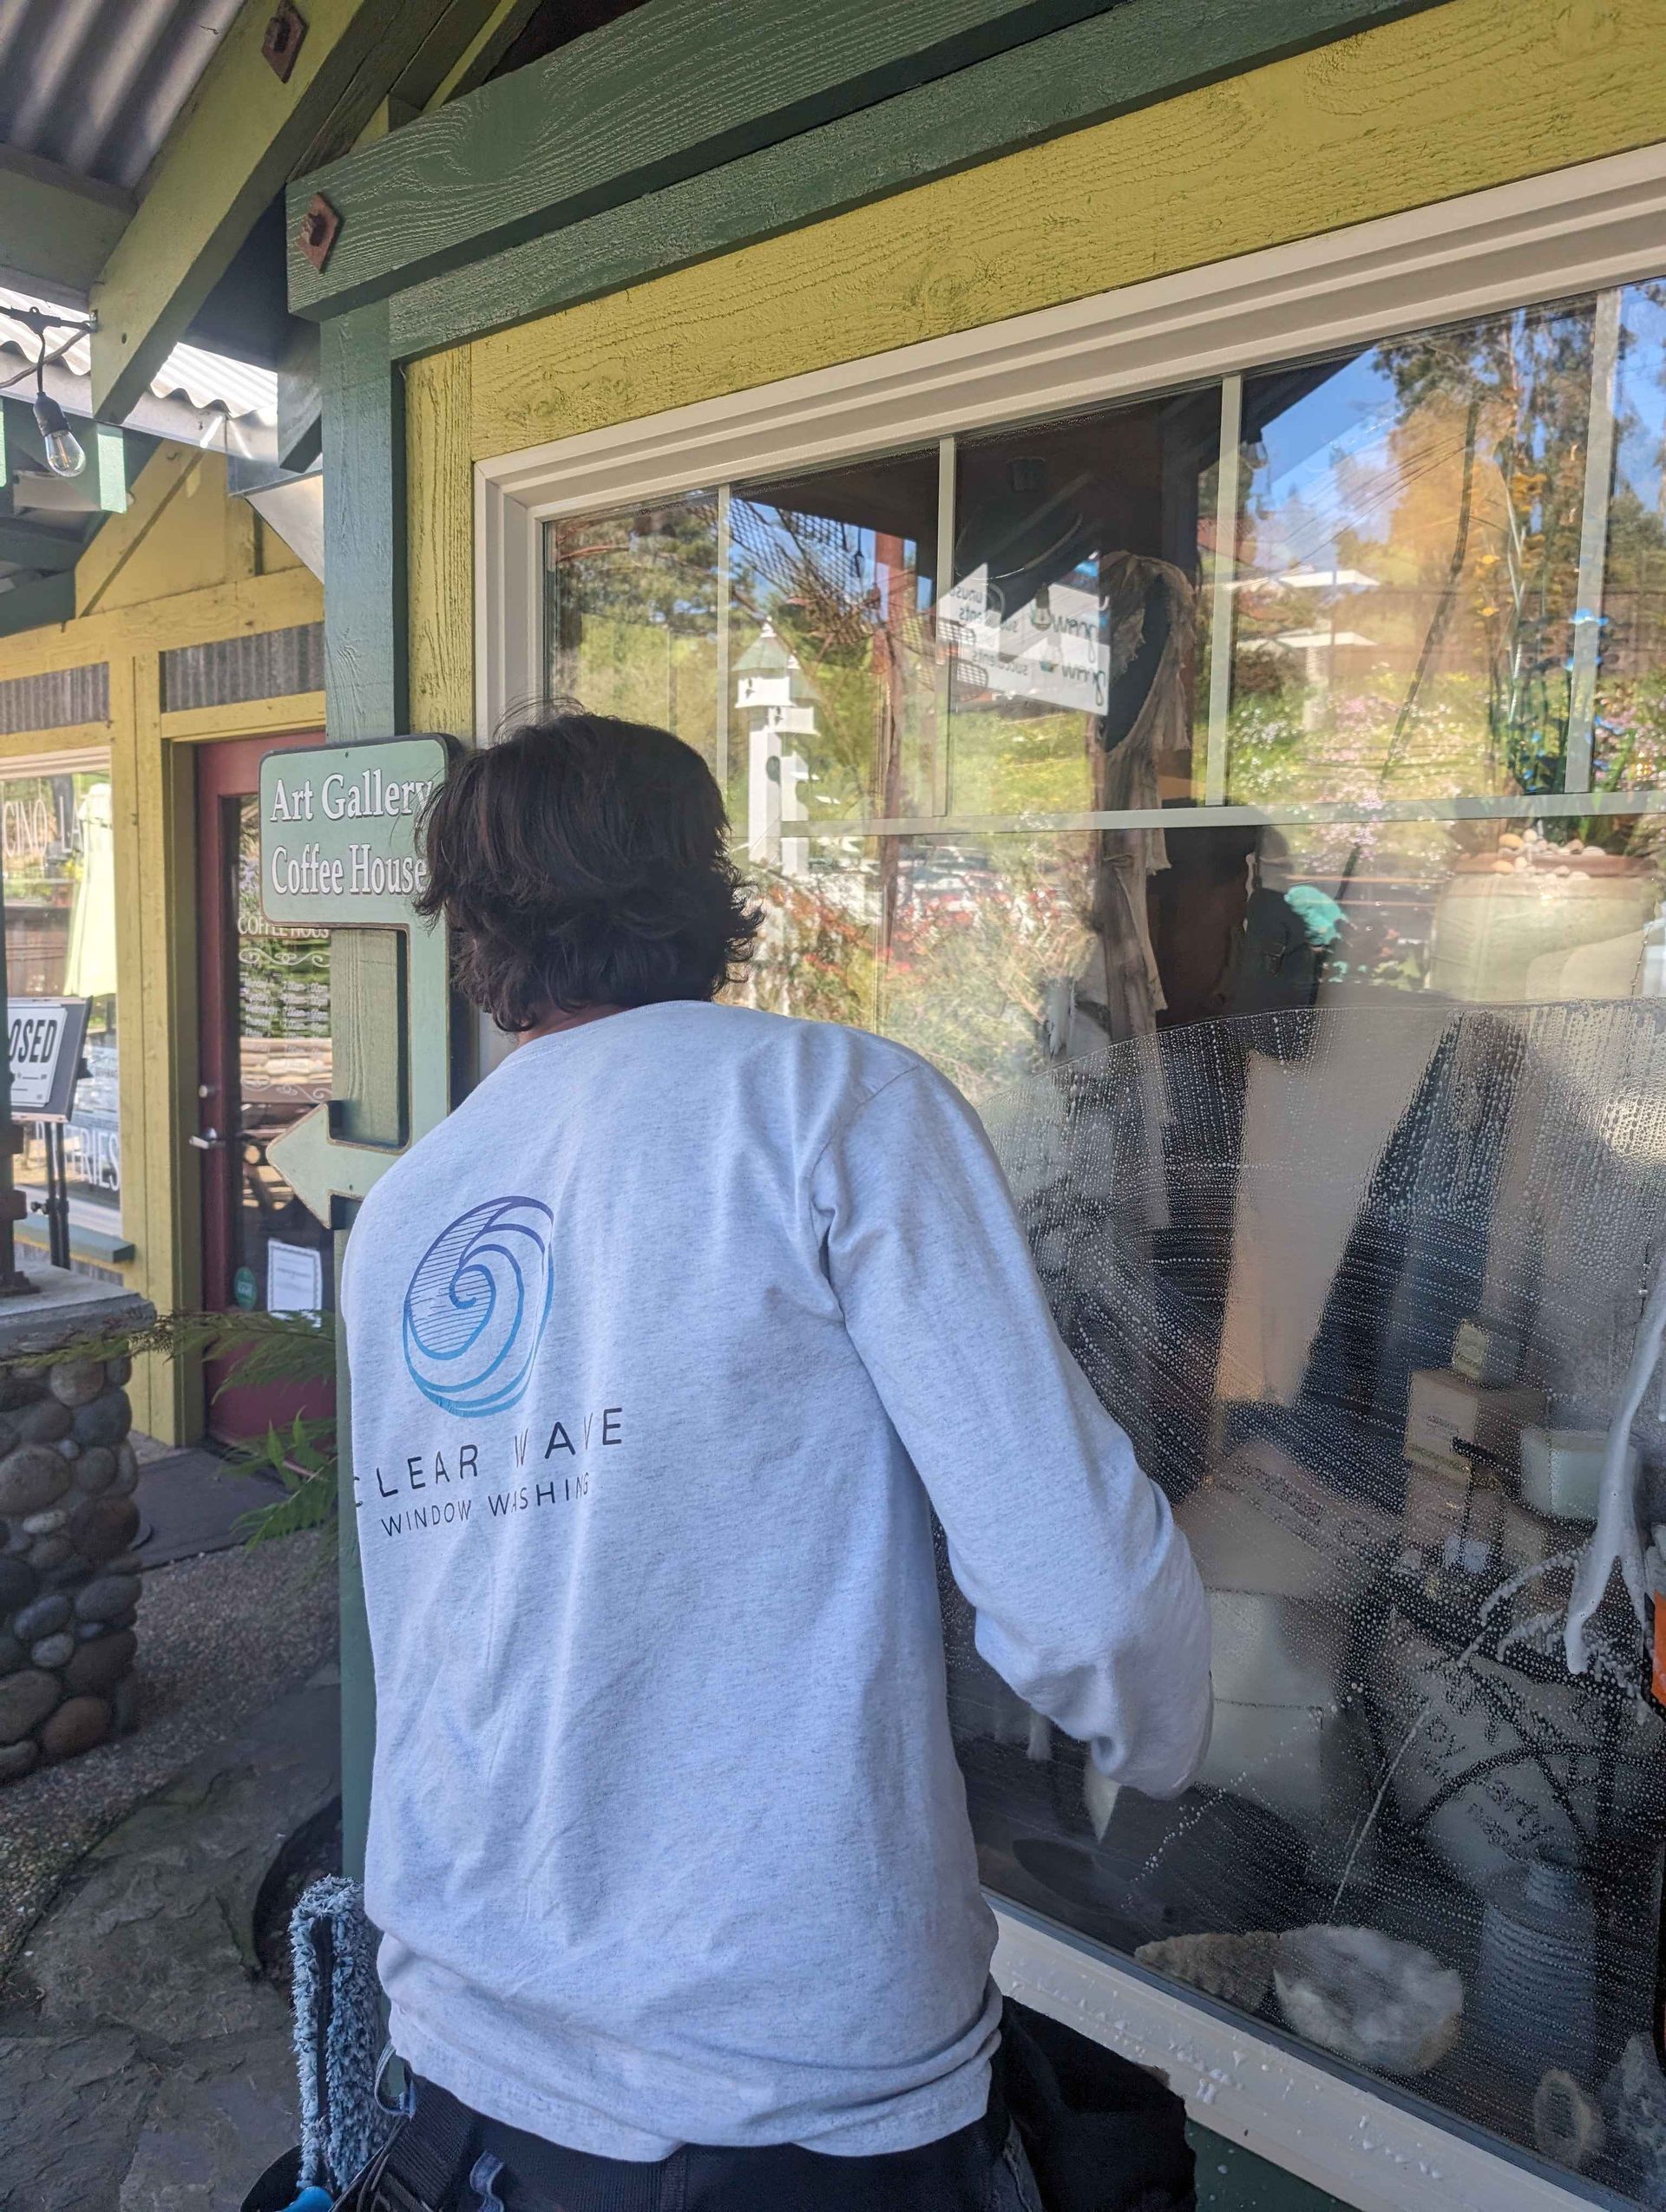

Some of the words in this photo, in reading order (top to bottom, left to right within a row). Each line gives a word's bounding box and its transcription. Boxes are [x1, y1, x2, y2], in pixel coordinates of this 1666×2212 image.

[270, 779, 313, 821] Art
[272, 843, 344, 894] Coffee
[350, 844, 431, 894] House
[354, 1444, 478, 1508] LEAR
[515, 1407, 622, 1468] WAVE
[381, 1500, 471, 1536] WINDOW
